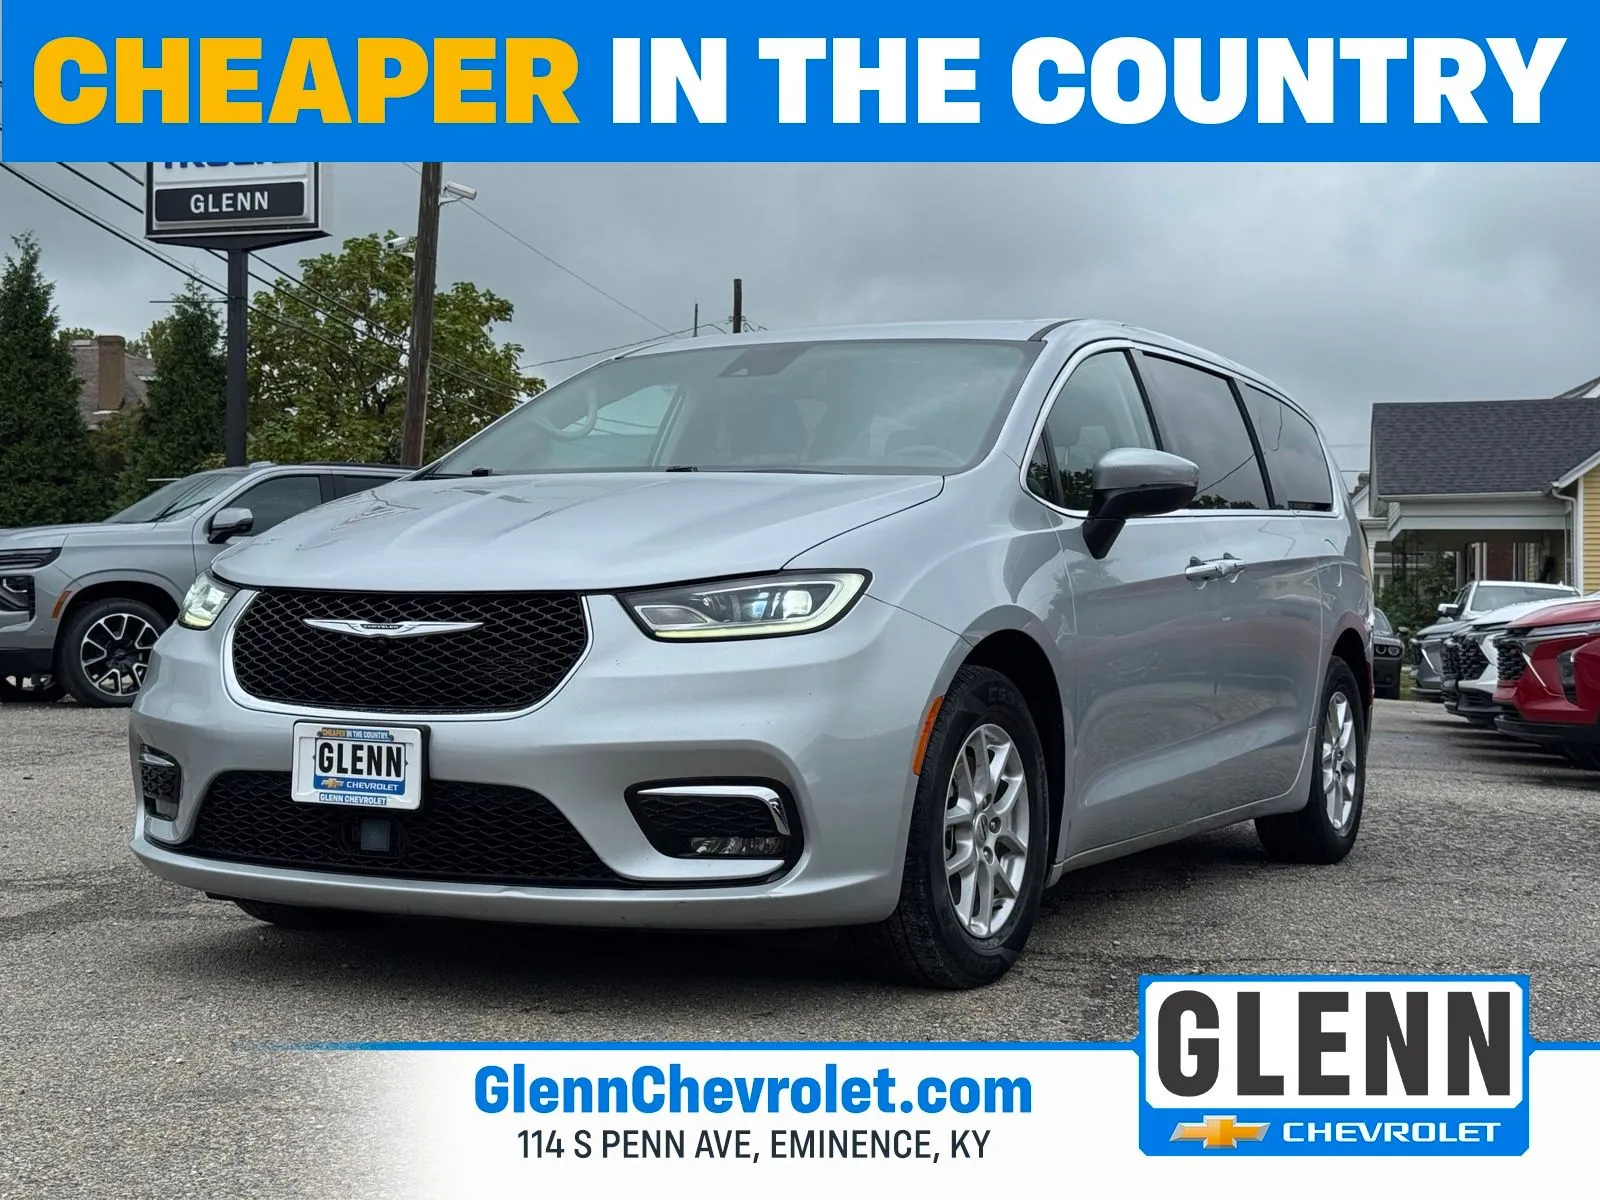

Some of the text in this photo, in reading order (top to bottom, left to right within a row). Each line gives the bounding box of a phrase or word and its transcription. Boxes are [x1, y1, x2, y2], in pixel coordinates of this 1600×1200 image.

[190, 191, 269, 214] GLENN
[347, 730, 353, 738] IN
[353, 730, 363, 738] THE
[318, 742, 402, 778] GLENN
[346, 781, 399, 791] CHEVROLET
[320, 793, 386, 805] GLENN CHEVROLET
